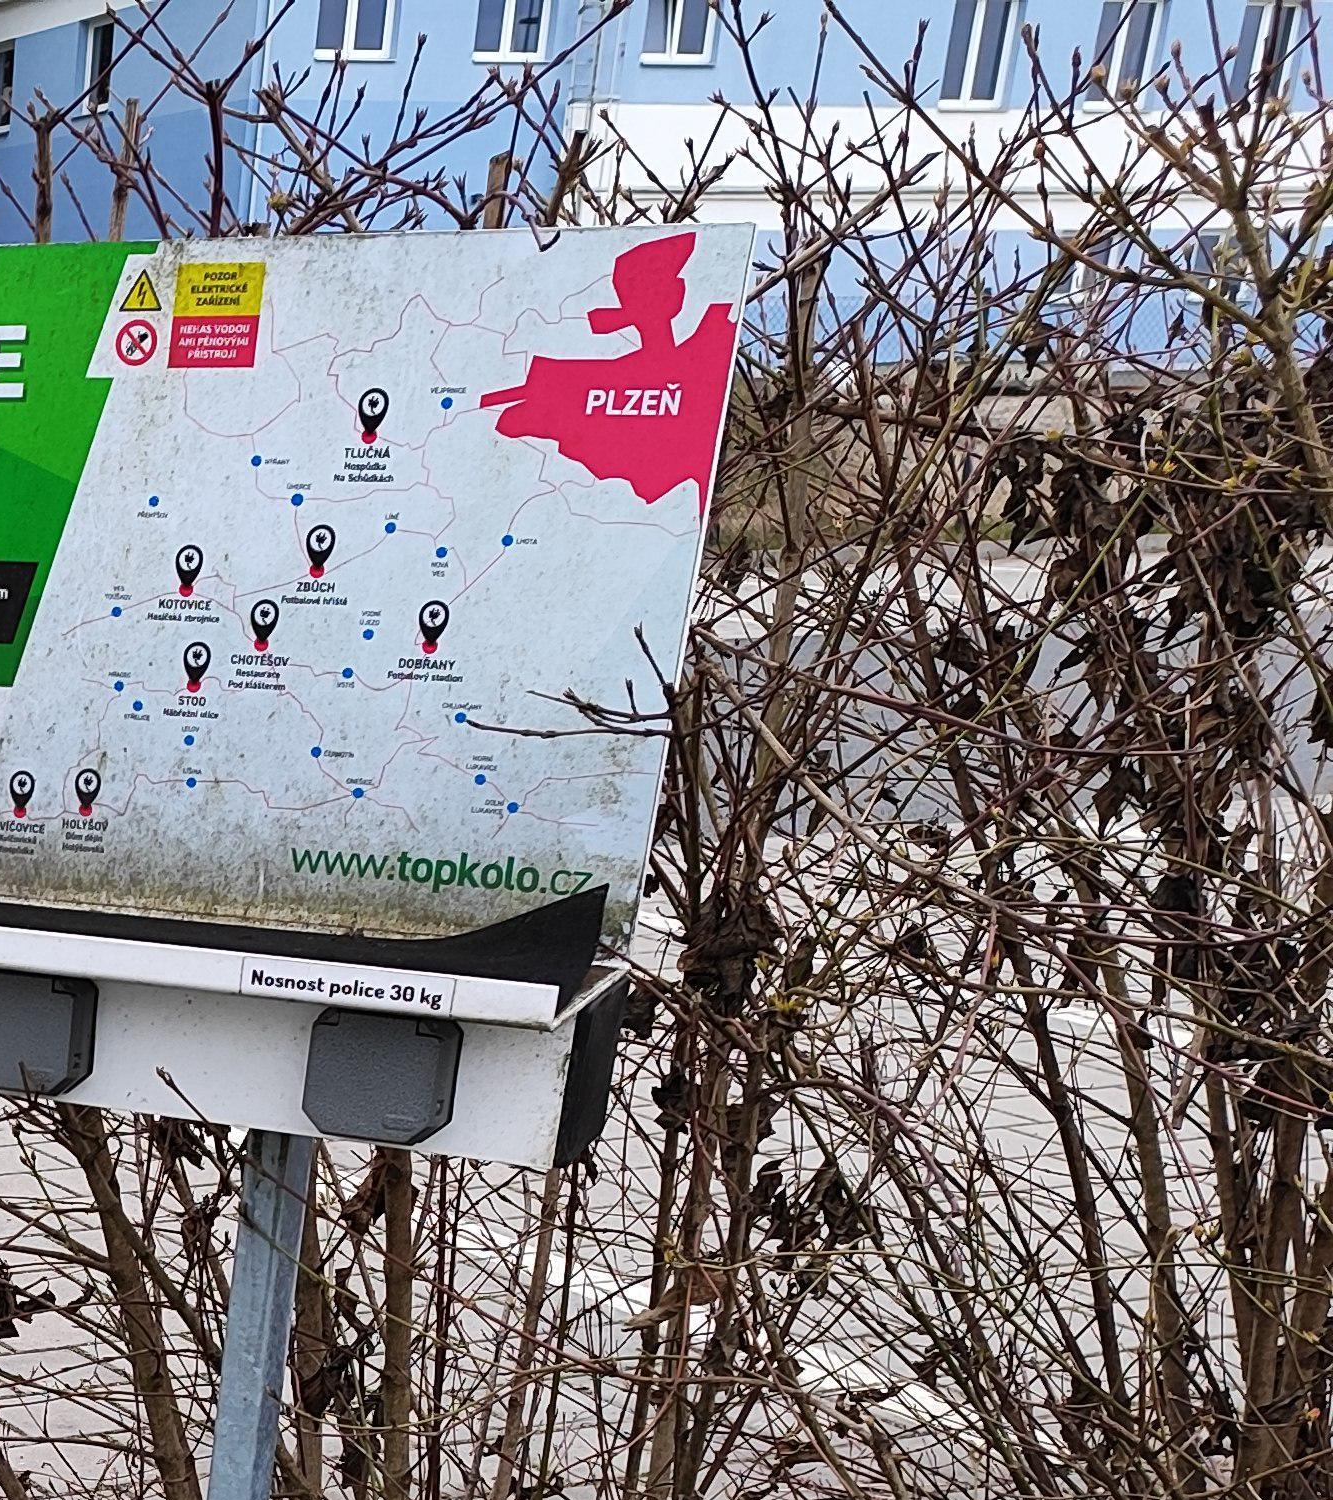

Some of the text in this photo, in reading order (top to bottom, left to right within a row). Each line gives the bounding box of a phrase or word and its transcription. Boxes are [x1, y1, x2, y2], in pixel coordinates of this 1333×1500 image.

[204, 271, 238, 281] POZOR
[190, 282, 248, 293] ELEKTRICKÉ
[196, 294, 241, 306] ZAŘÍZENÍ
[180, 324, 251, 334] NEHAS VODOU
[178, 337, 195, 346] ANI
[187, 348, 237, 359] PŘÍSTROJI
[585, 382, 683, 416] PLZEŇ
[344, 445, 391, 459] TLUČNÁ
[333, 474, 345, 482] Na
[296, 580, 335, 593] ZBŮCH
[158, 599, 212, 611] KOTOVICE
[230, 653, 290, 667] CHOTĚŠOV
[398, 656, 456, 671] DOBŘANY
[431, 673, 463, 682] stadion
[228, 680, 243, 688] Pod
[178, 695, 206, 706] STOD
[201, 711, 219, 719] ulice
[61, 818, 108, 832] HOLÝŠOV
[291, 847, 594, 896] www.topkolo.cz
[251, 968, 443, 1011] Nosnost police 30 kg
